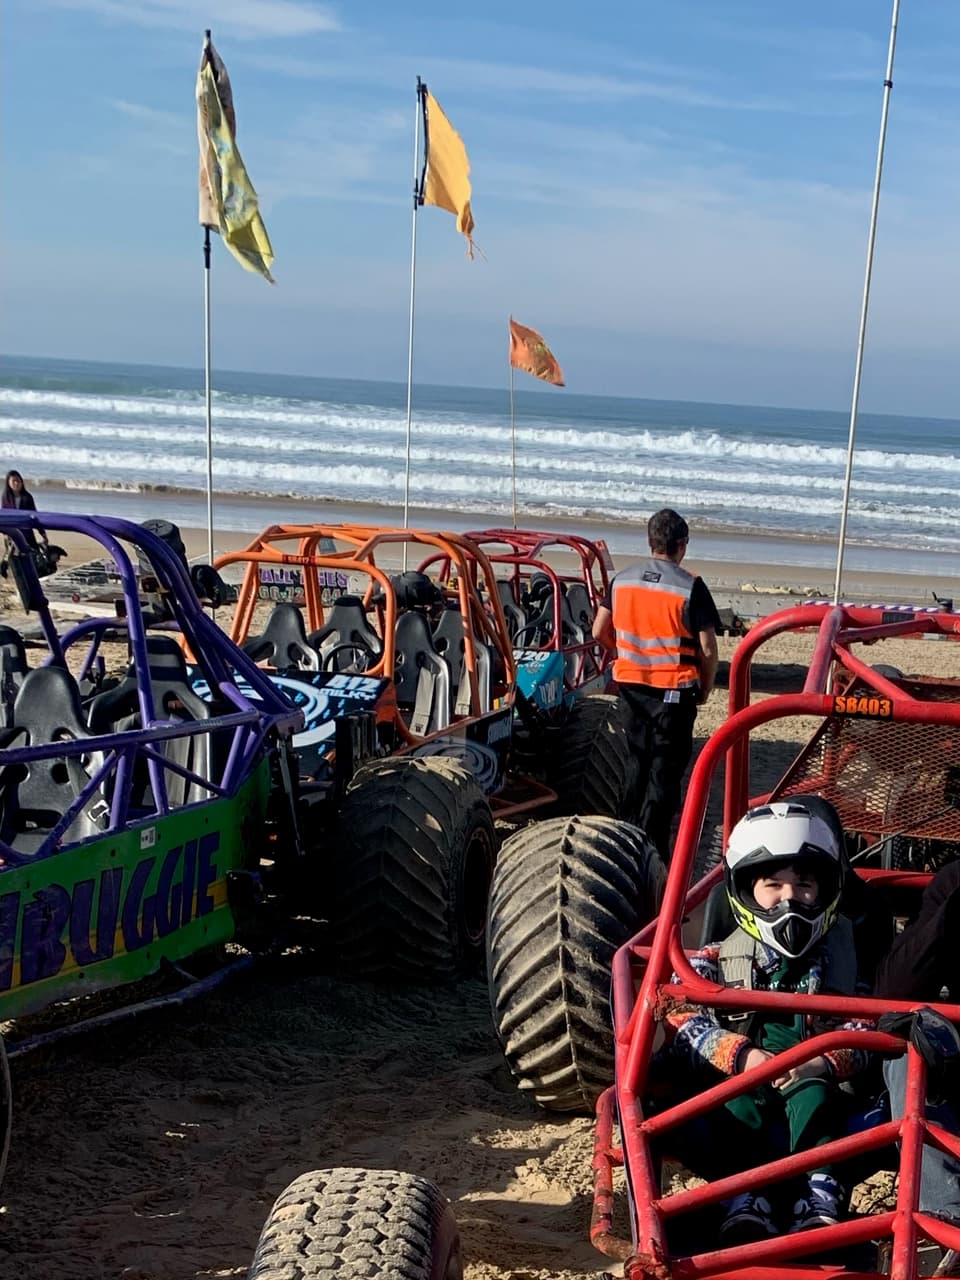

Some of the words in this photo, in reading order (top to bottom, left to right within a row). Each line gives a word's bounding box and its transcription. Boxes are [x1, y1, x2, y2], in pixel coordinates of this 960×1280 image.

[261, 569, 293, 584] ALL
[300, 572, 348, 587] GES
[326, 674, 382, 691] 412
[320, 687, 376, 699] MILKY
[835, 696, 891, 716] SB403
